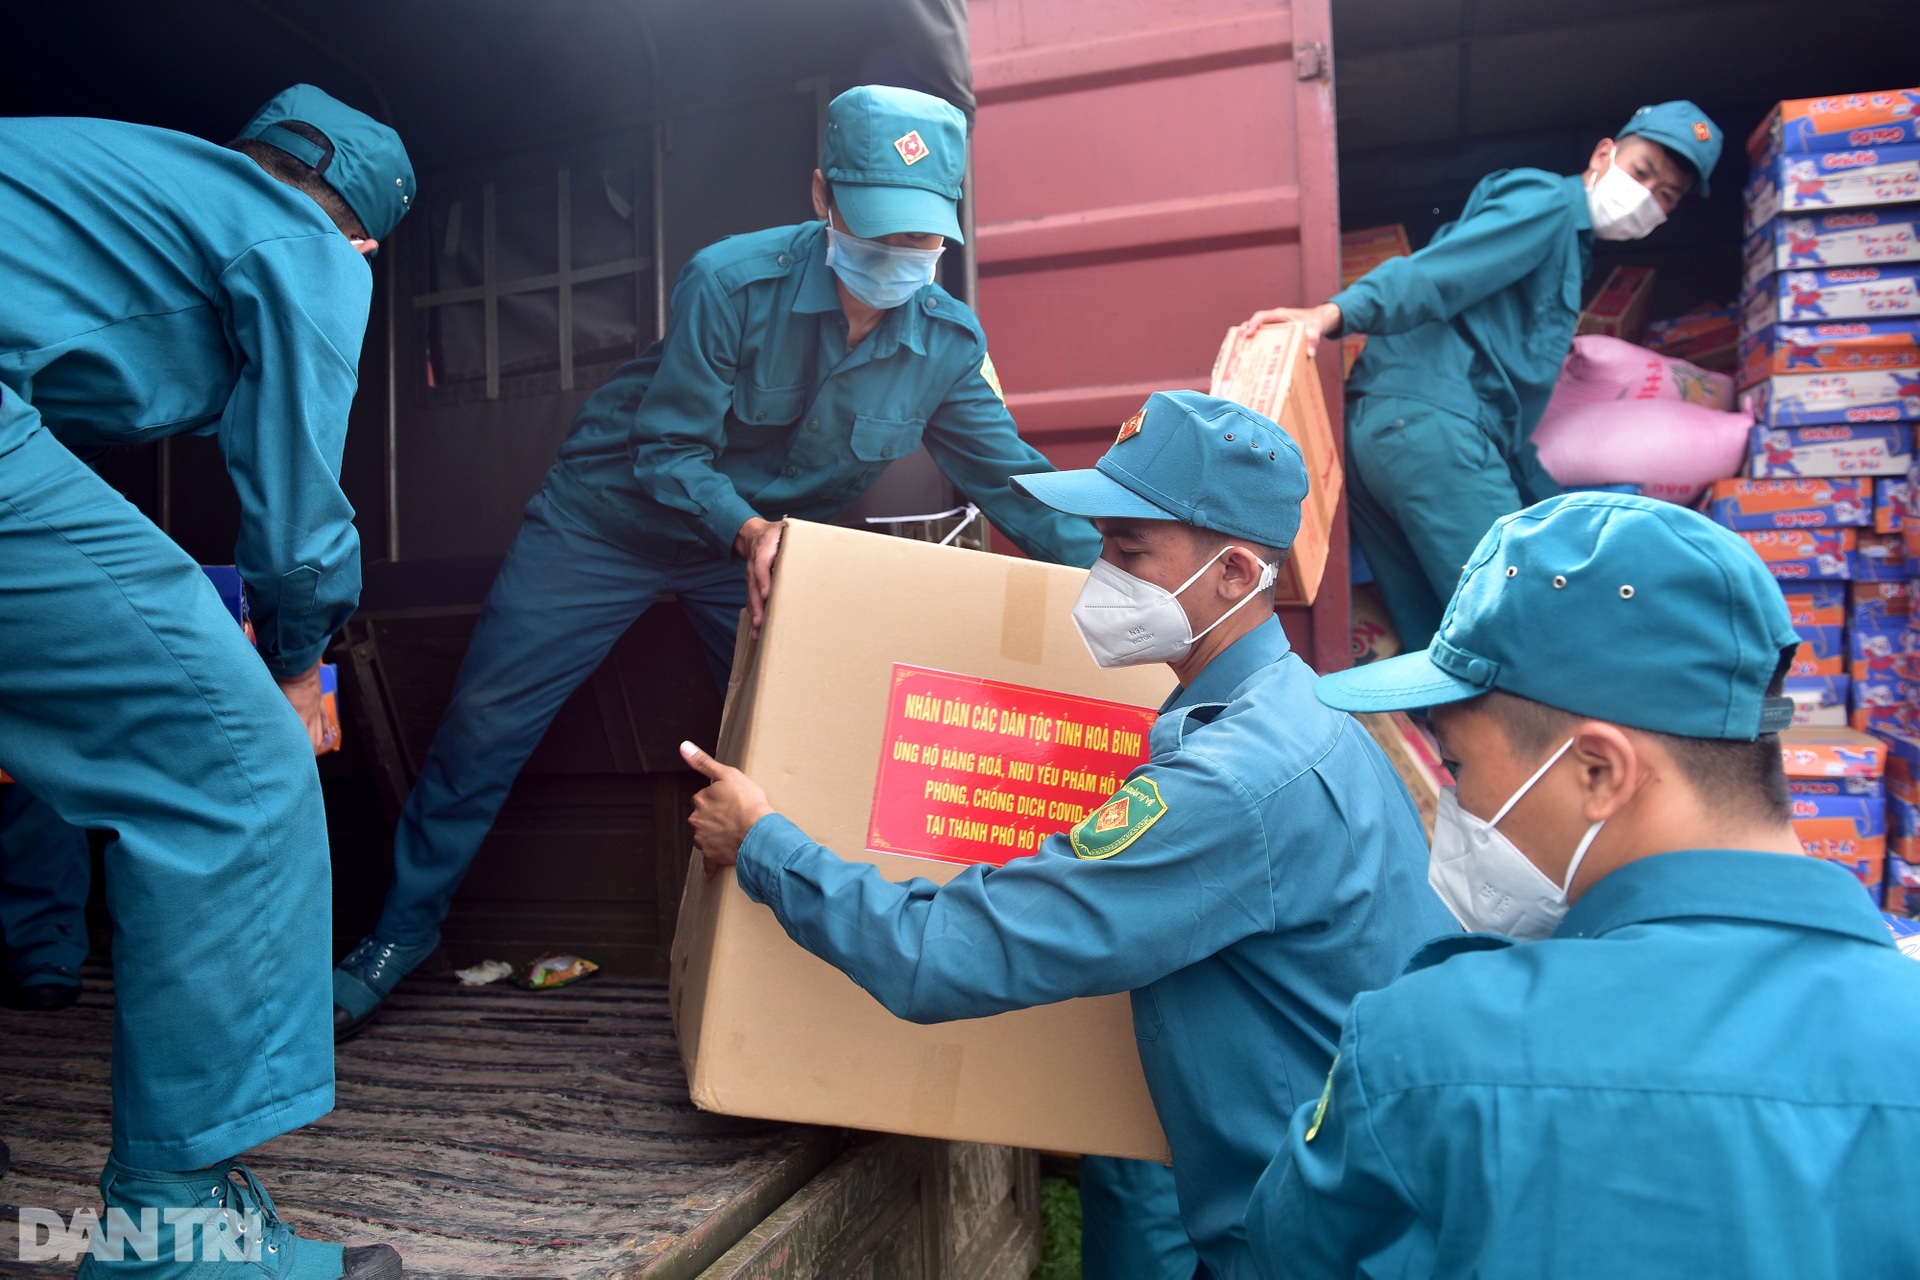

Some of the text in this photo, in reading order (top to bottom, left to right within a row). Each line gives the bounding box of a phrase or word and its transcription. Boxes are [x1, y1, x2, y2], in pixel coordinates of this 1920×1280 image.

[904, 691, 1141, 758] NHÂN DÂN CÁC DÂN TỘC TỈNH HOÀ BÌNH
[893, 735, 920, 763] ỦNG
[921, 743, 939, 771] HỘ
[941, 746, 975, 773] HÀNG
[1008, 760, 1034, 782] NHU
[1037, 761, 1060, 787] YẾU
[1061, 765, 1097, 793] PHẨM
[1098, 770, 1116, 796] HỖ
[973, 784, 1015, 813] CHỐNG
[1017, 795, 1046, 820] DỊCH
[925, 814, 946, 839] TẠI
[948, 816, 989, 843] THÀNH
[989, 821, 1017, 847] PHỐ
[1017, 824, 1036, 850] HỒ
